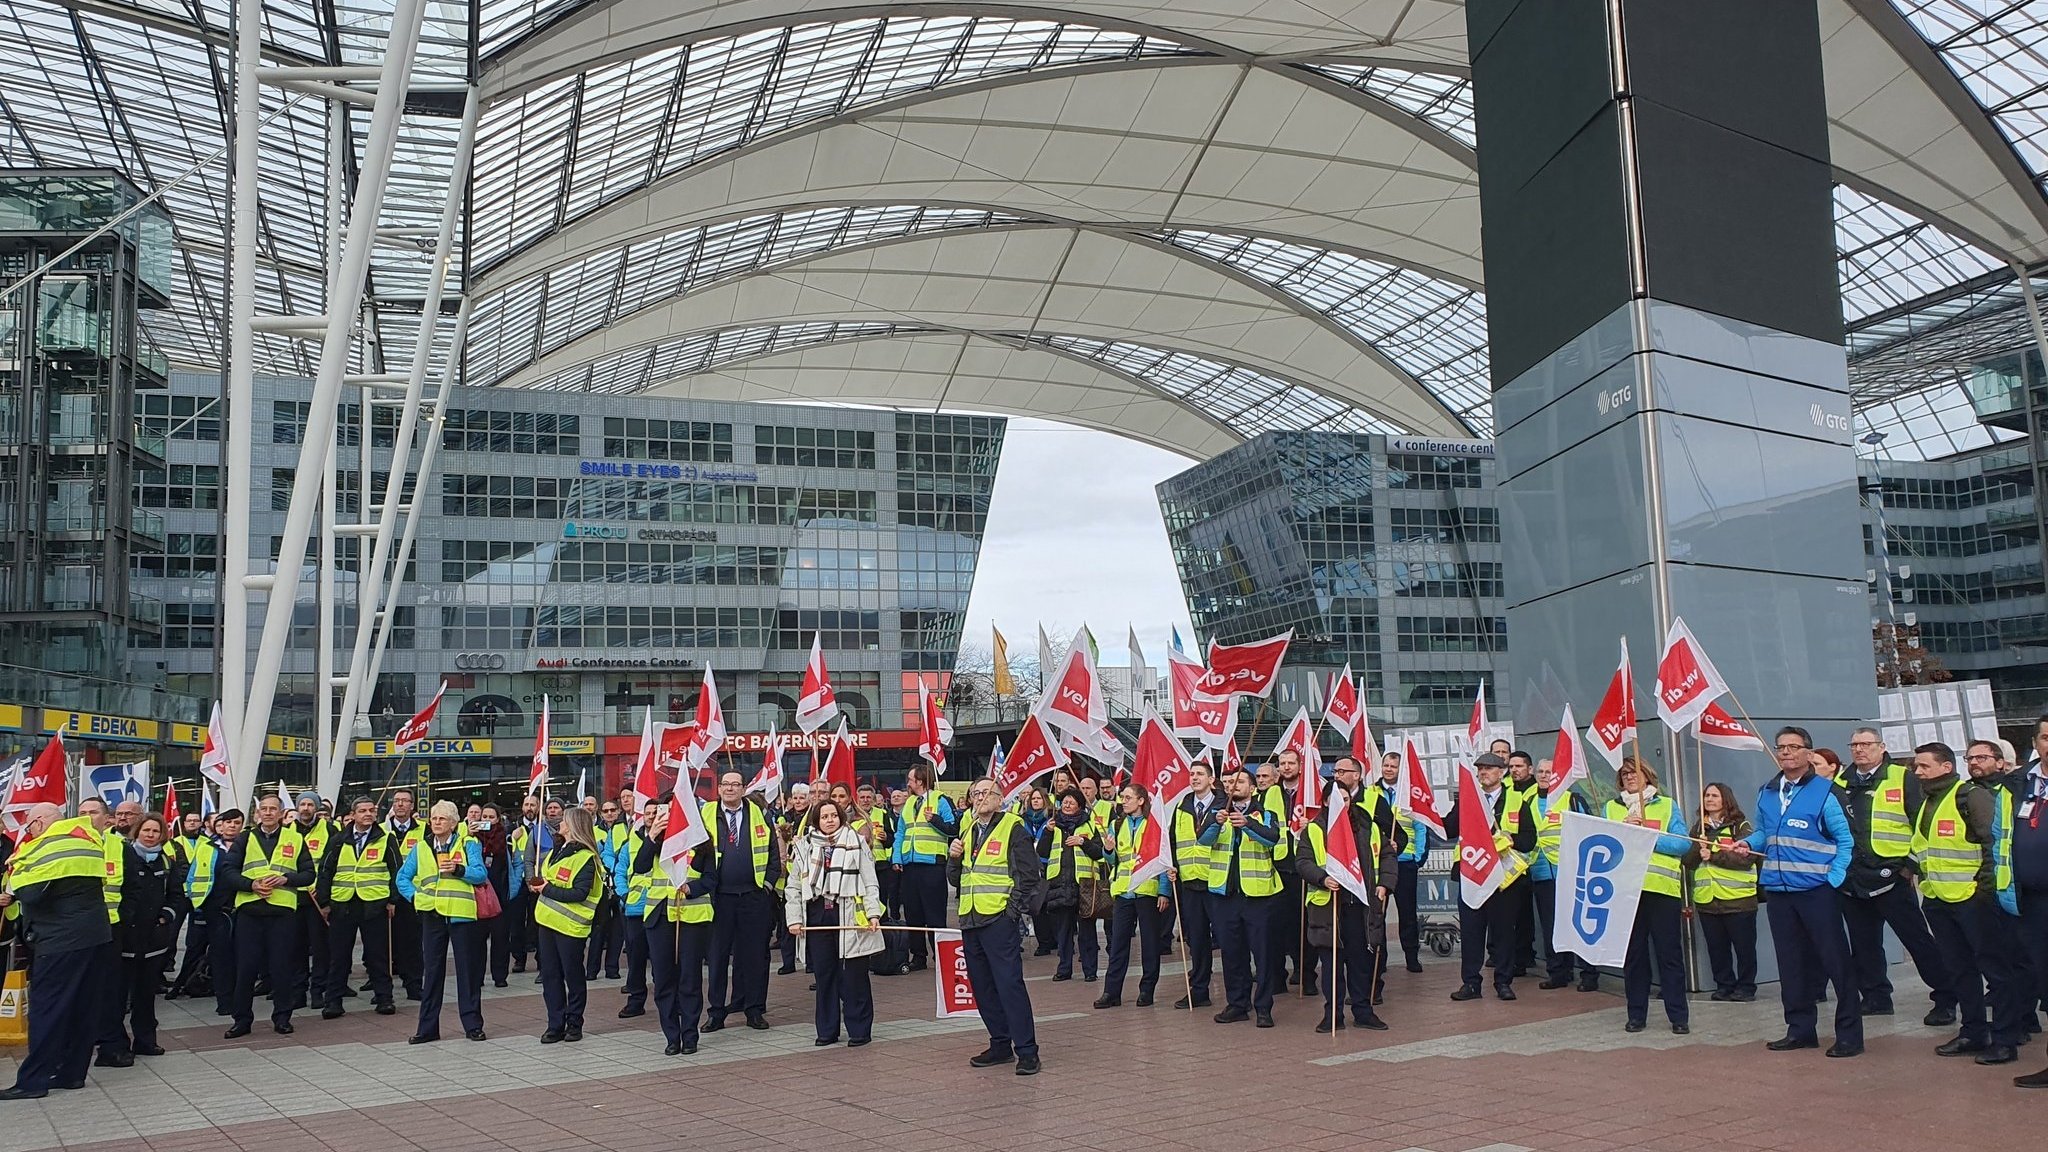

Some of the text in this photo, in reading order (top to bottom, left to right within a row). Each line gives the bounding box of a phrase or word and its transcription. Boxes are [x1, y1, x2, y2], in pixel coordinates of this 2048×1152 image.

[1611, 385, 1632, 409] GTG
[1826, 413, 1848, 431] GTG
[1405, 440, 1494, 454] conference cent
[580, 461, 632, 476] SMILE
[637, 464, 681, 479] EYES
[537, 657, 694, 668] Audi Conference Center
[91, 715, 138, 737] EDEKA
[549, 739, 590, 747] Eingang
[726, 736, 745, 749] FC
[818, 733, 868, 748] STRE
[418, 768, 429, 818] EDEKA
